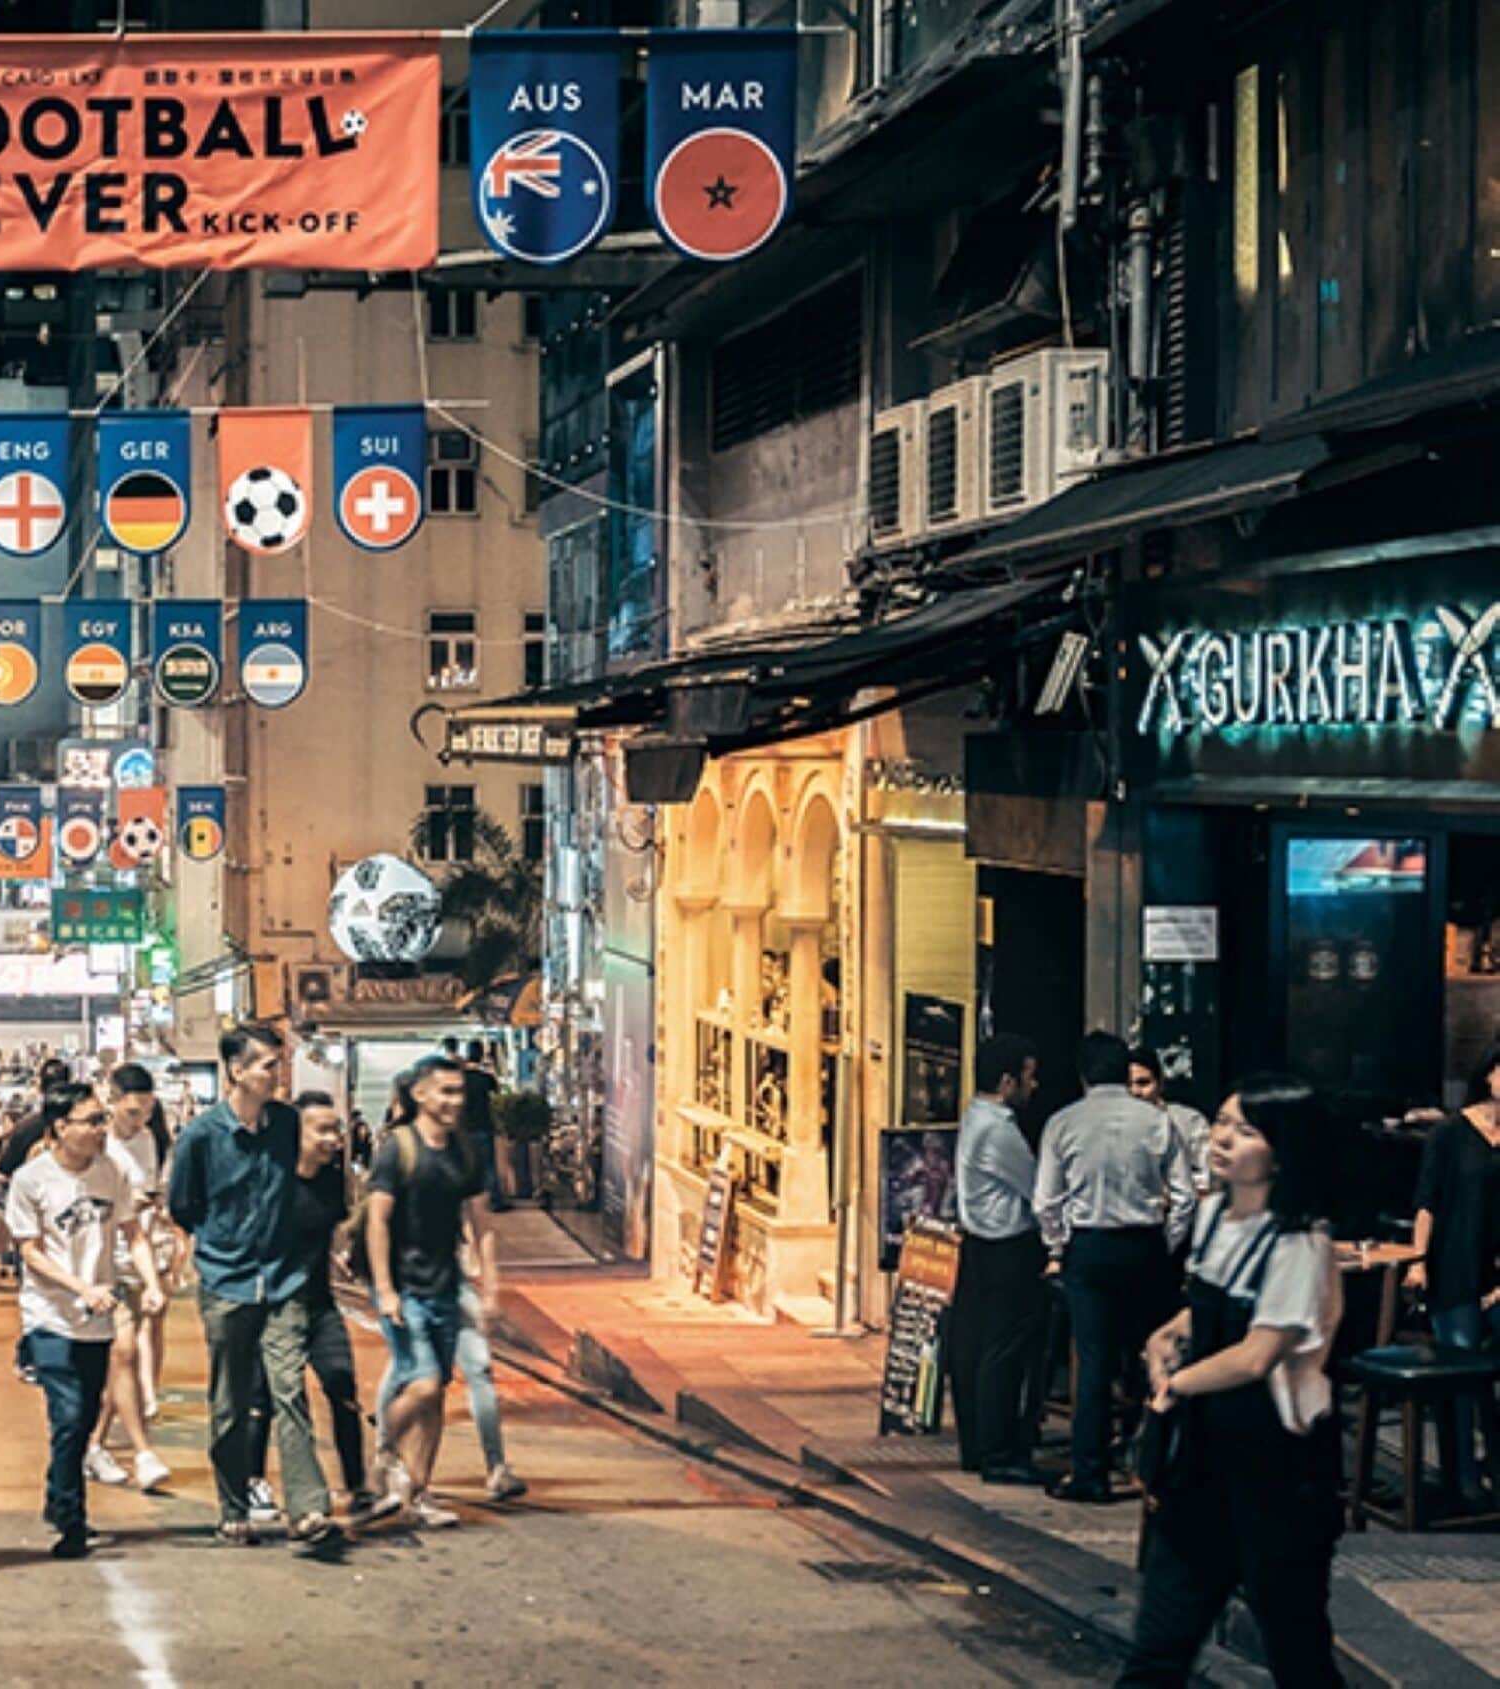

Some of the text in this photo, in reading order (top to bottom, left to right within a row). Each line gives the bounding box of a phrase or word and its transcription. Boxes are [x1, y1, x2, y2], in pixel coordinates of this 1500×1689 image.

[2, 69, 55, 88] CARD
[508, 84, 582, 114] AUS
[681, 81, 764, 111] MAR
[201, 211, 359, 234] KICK-OFF
[120, 439, 170, 462] GER
[360, 435, 400, 457] SUI
[79, 620, 118, 637] EGY
[169, 622, 206, 638] KSA
[255, 621, 293, 637] ARG
[1199, 621, 1414, 726] GURKHA
